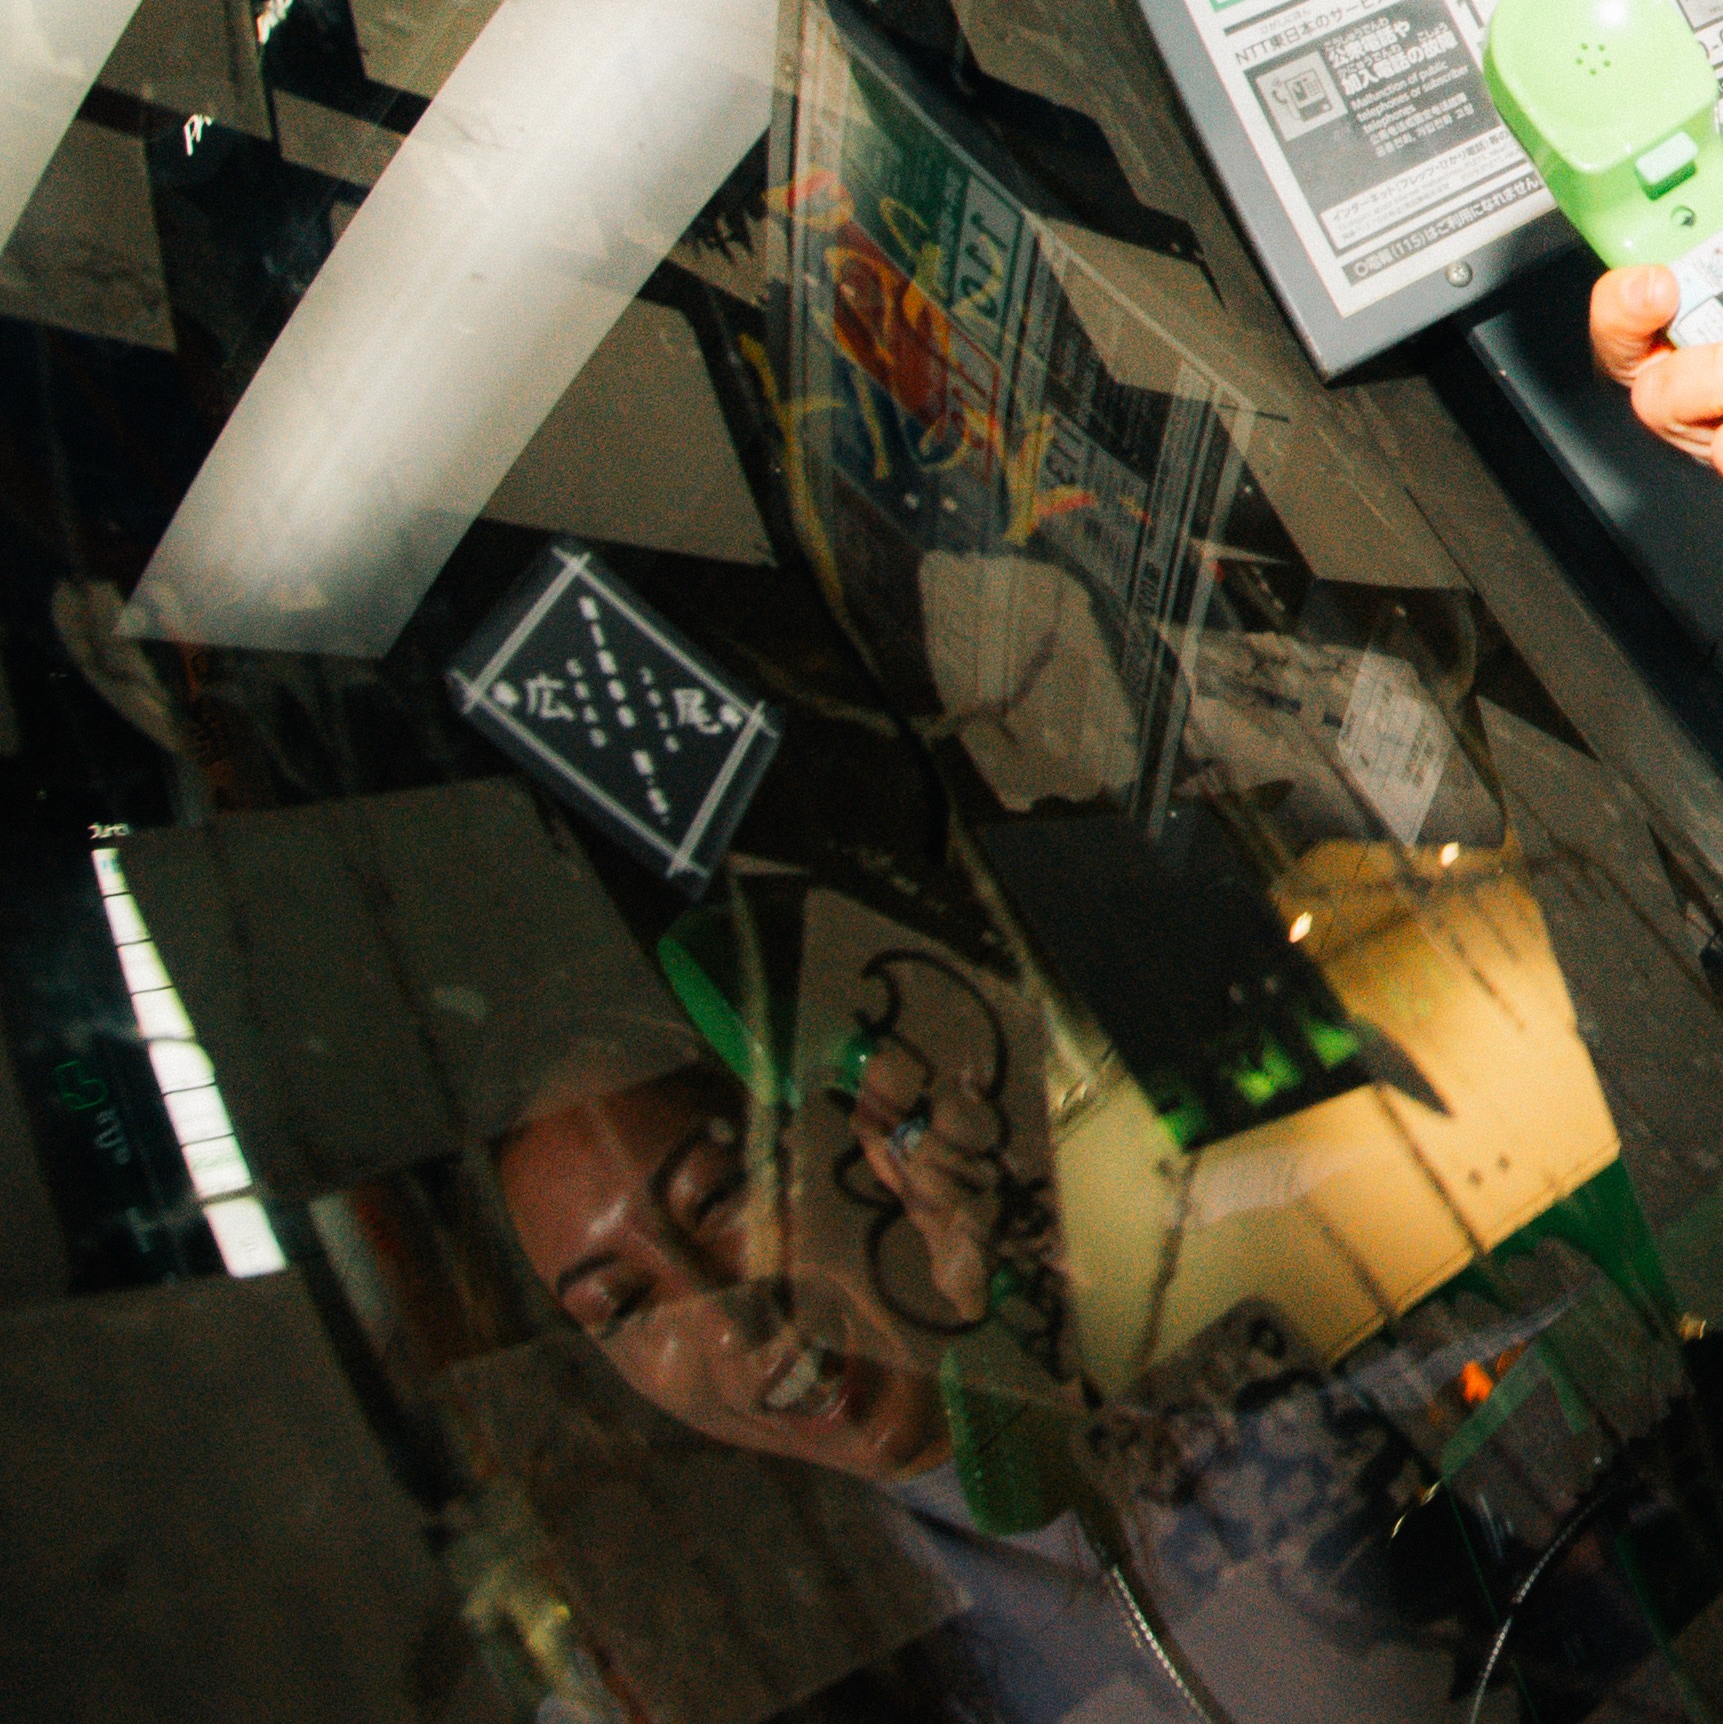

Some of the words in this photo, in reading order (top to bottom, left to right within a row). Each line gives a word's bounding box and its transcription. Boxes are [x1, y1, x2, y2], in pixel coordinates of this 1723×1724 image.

[1328, 20, 1410, 68] 公衆電話や
[1340, 30, 1457, 94] 加入電話の故障
[1349, 76, 1408, 111] Malfunction
[1416, 58, 1450, 82] public
[1355, 90, 1412, 124] telephones
[1419, 63, 1470, 93] subscriber
[1360, 102, 1418, 136] telephones
